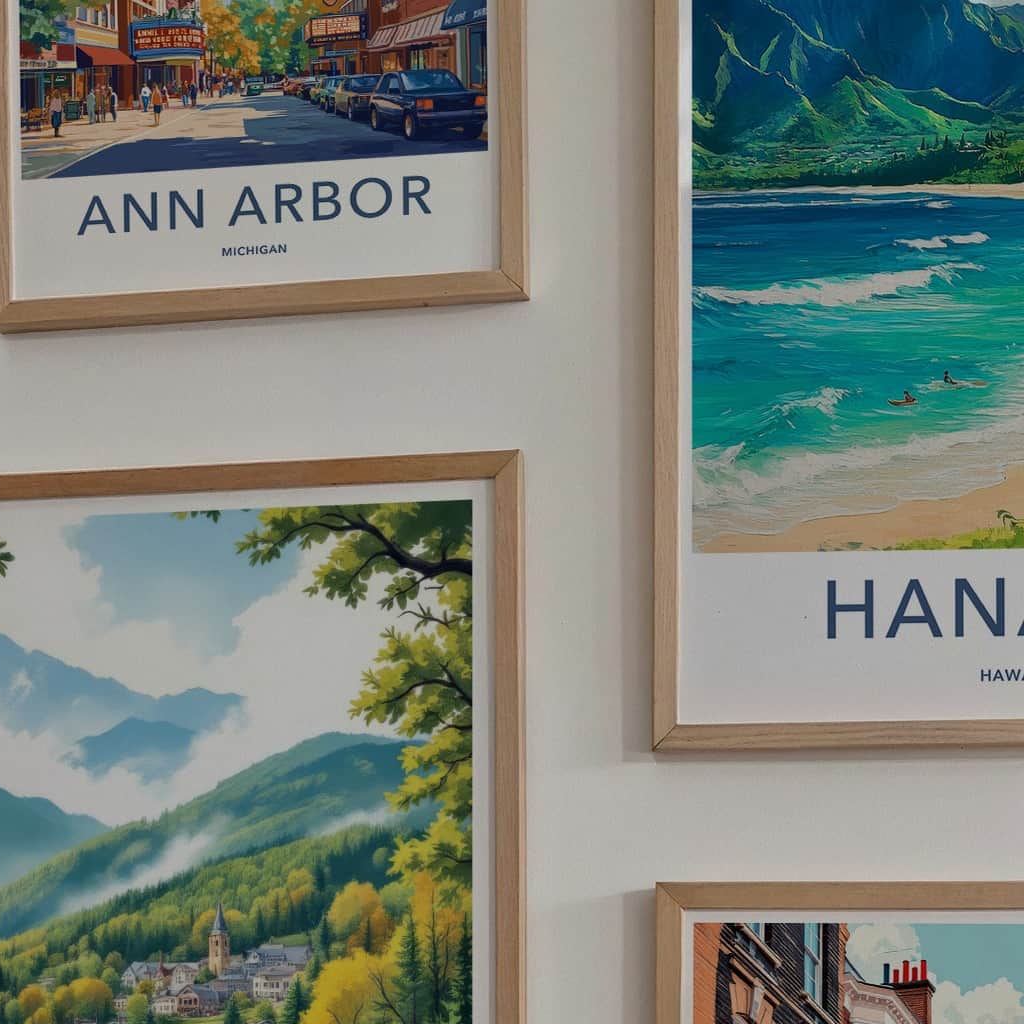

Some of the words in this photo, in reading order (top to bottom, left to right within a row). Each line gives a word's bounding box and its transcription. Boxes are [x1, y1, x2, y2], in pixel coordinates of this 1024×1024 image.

[77, 188, 205, 237] ANN
[227, 175, 432, 227] ARBOR
[221, 243, 288, 257] MICHIGAN
[826, 577, 1024, 640] HAN
[979, 668, 1024, 682] HAW
